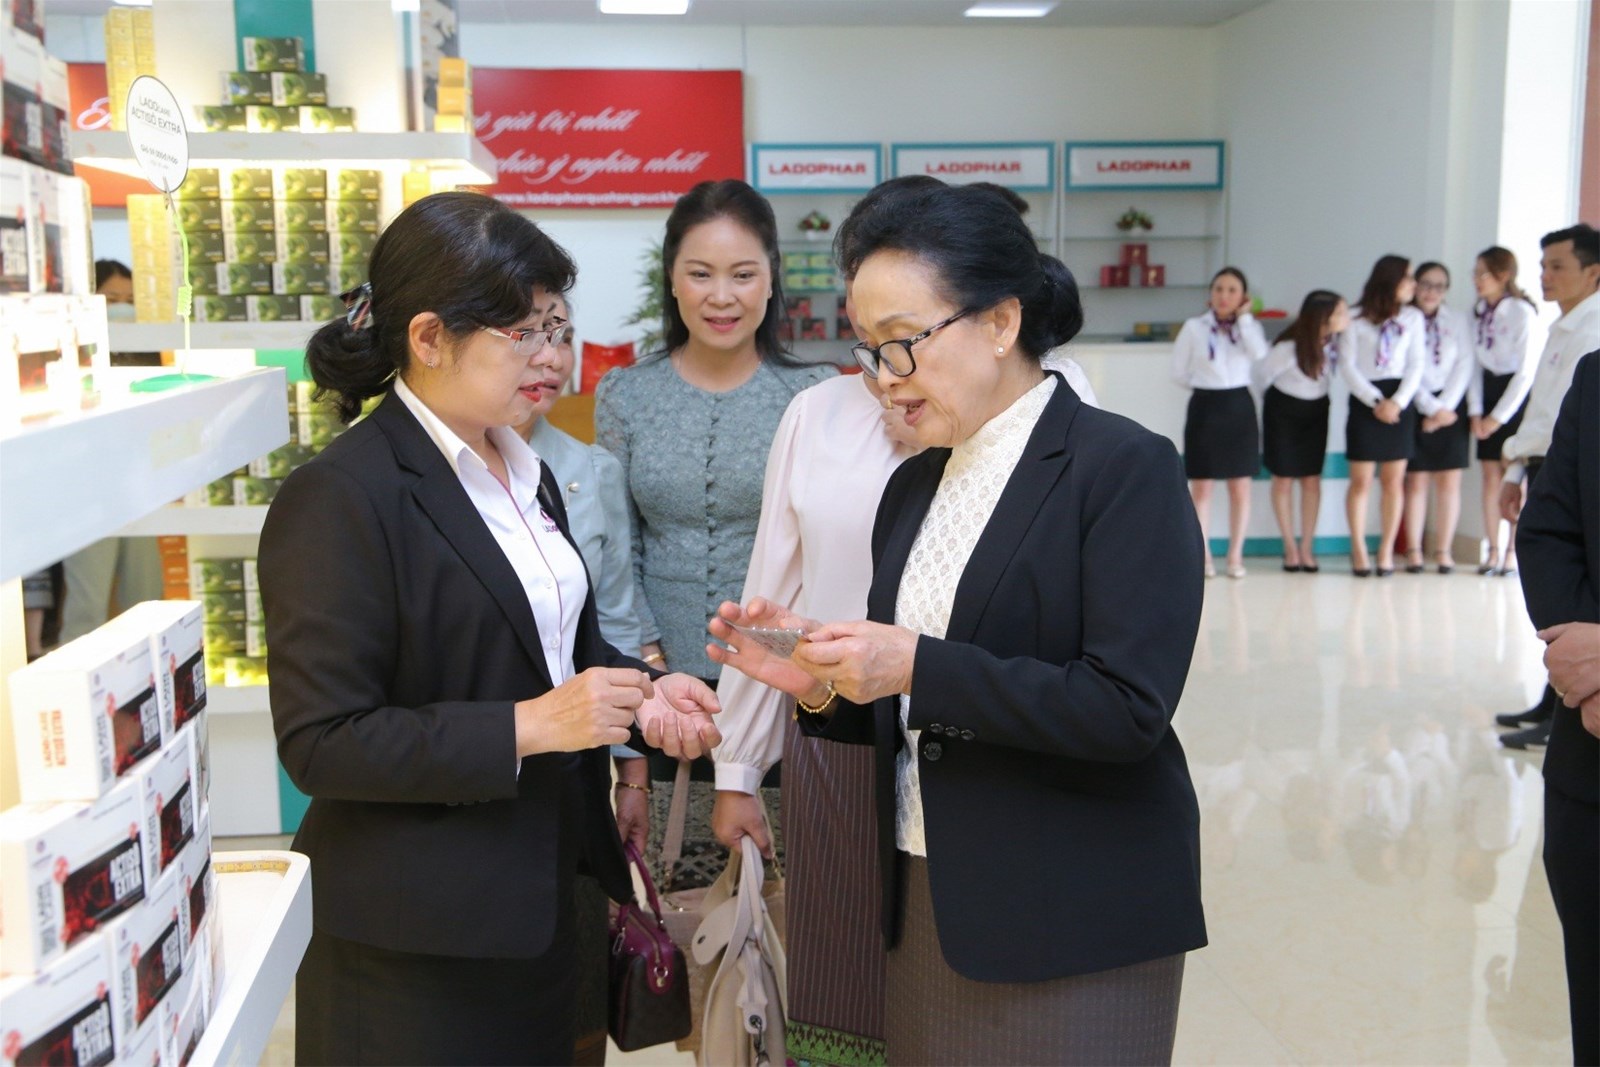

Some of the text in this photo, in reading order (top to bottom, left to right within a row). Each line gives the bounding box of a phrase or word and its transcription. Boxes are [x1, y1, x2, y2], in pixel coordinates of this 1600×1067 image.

[157, 117, 182, 135] EXTRA
[768, 162, 867, 175] LADOPHAR
[925, 161, 1022, 174] LADOPHAR
[1096, 160, 1192, 173] LADOPHAR
